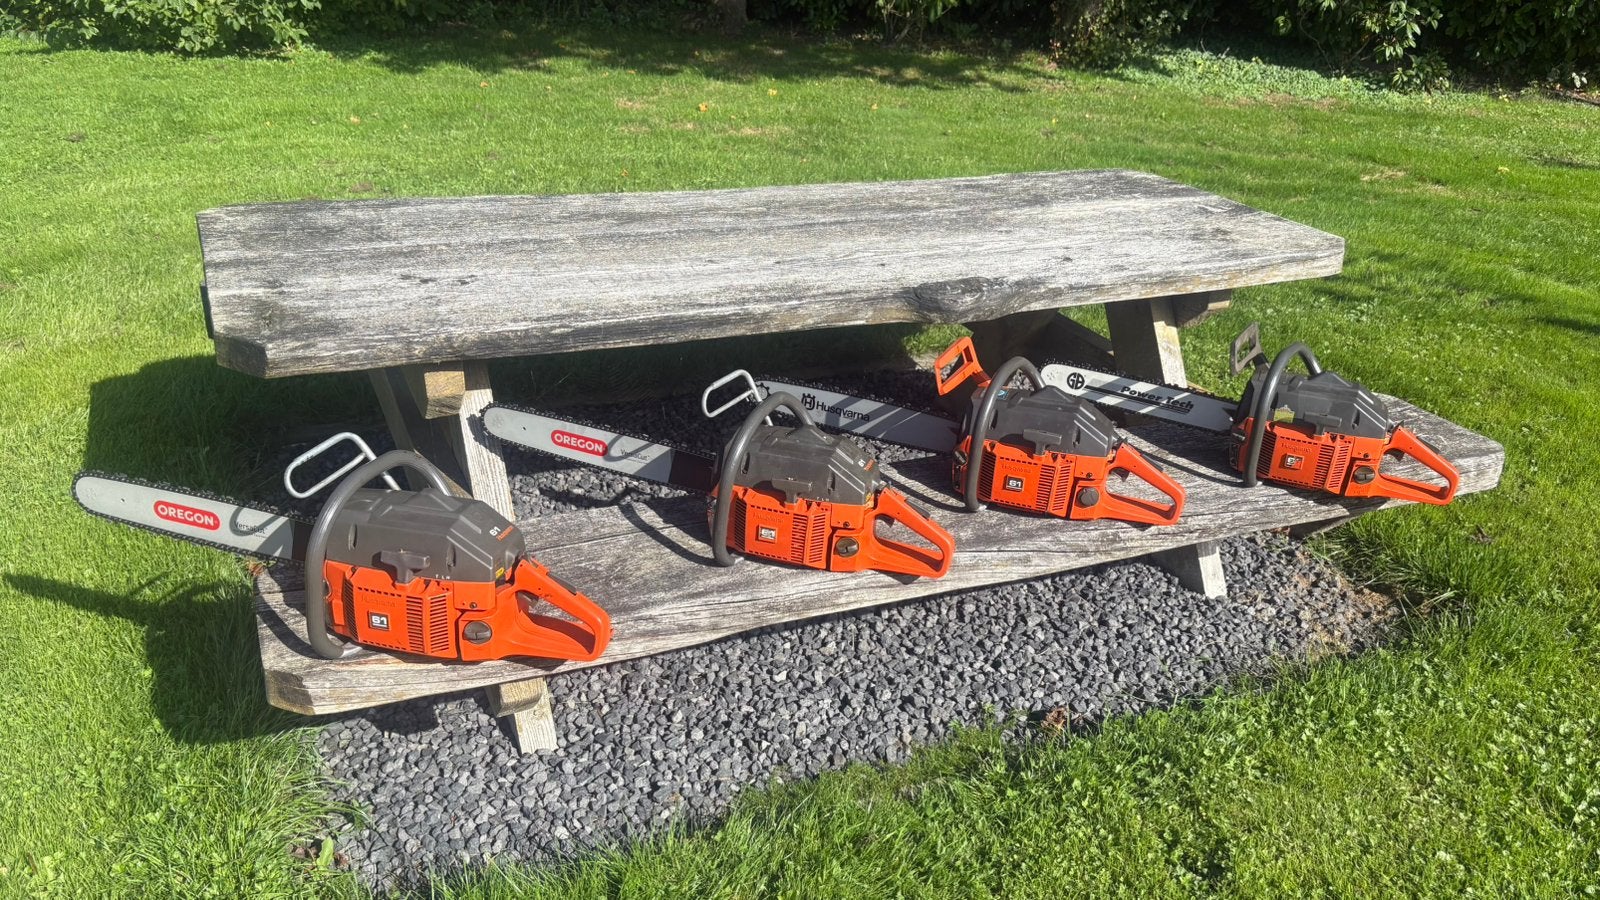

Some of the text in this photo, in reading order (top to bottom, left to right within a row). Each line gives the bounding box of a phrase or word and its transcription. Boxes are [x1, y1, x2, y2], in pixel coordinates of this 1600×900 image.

[1066, 372, 1085, 390] GB
[1120, 386, 1163, 401] Power
[1165, 396, 1194, 410] Tech
[816, 401, 870, 422] Husqvarna
[554, 433, 603, 453] OREGON
[157, 504, 215, 526] OREGON
[489, 526, 501, 536] 61
[371, 615, 387, 625] 61
